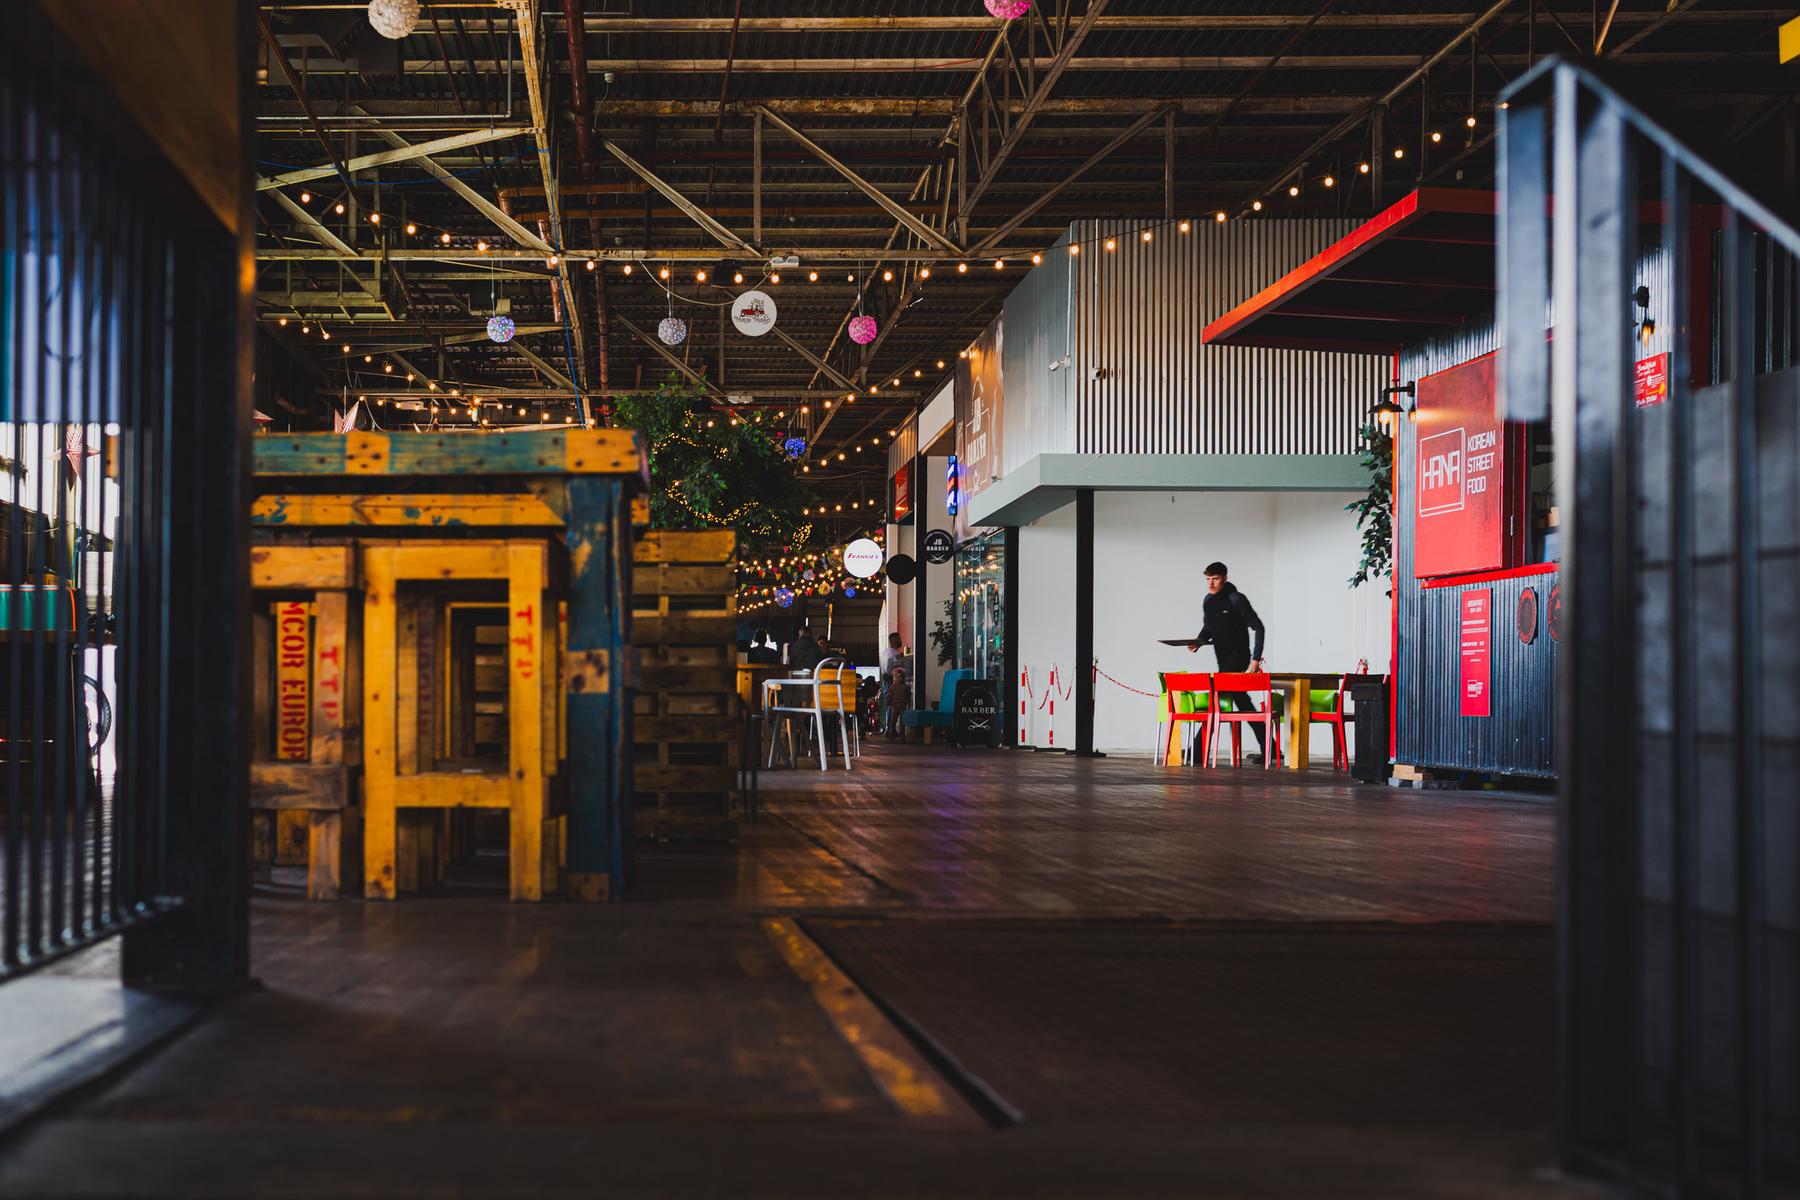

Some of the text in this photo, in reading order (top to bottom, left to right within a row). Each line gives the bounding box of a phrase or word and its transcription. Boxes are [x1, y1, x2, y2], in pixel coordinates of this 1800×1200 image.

[1467, 430, 1496, 452] KOREAN
[1422, 449, 1461, 492] HANA
[1467, 452, 1495, 474] STREET
[1466, 475, 1487, 495] FOOD
[961, 706, 996, 714] BARBER
[973, 698, 984, 706] JB
